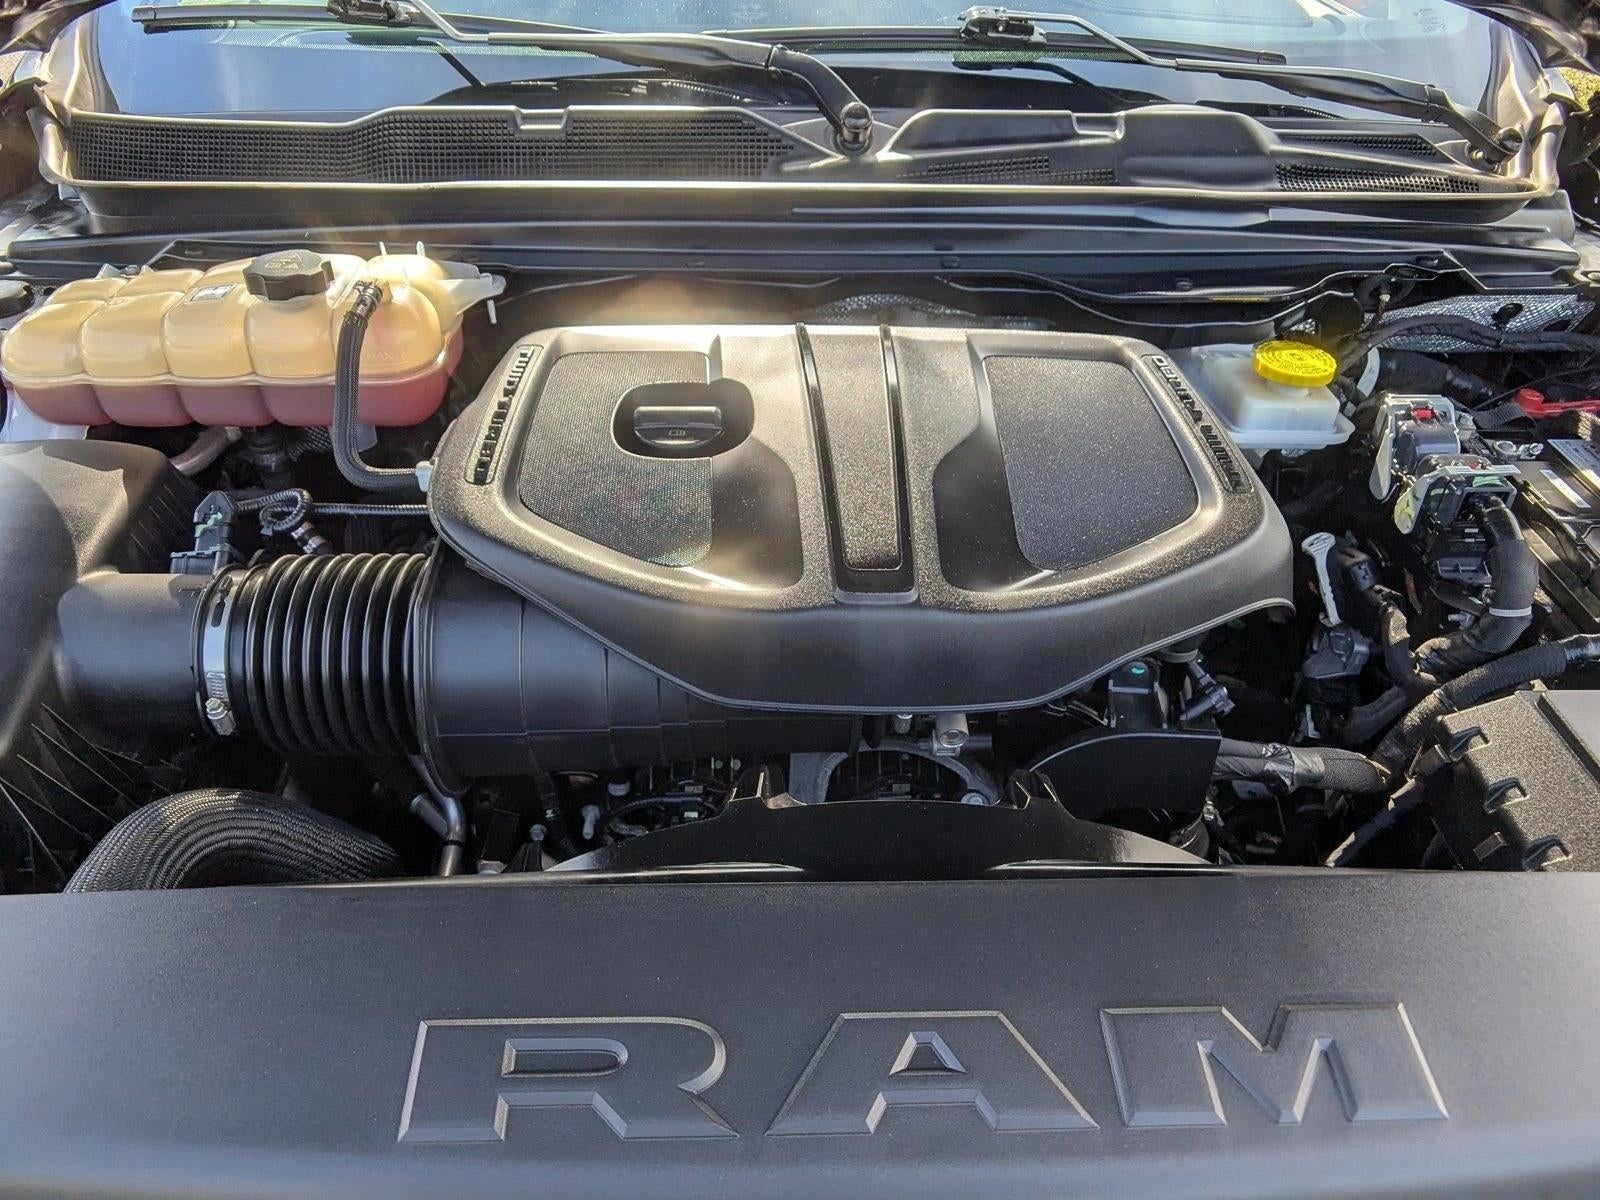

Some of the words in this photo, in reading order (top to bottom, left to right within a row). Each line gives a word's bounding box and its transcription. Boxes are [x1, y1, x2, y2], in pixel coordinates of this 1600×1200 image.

[1151, 355, 1202, 423] TURBO
[474, 395, 513, 484] TURBO
[397, 1001, 1450, 1143] RAM
